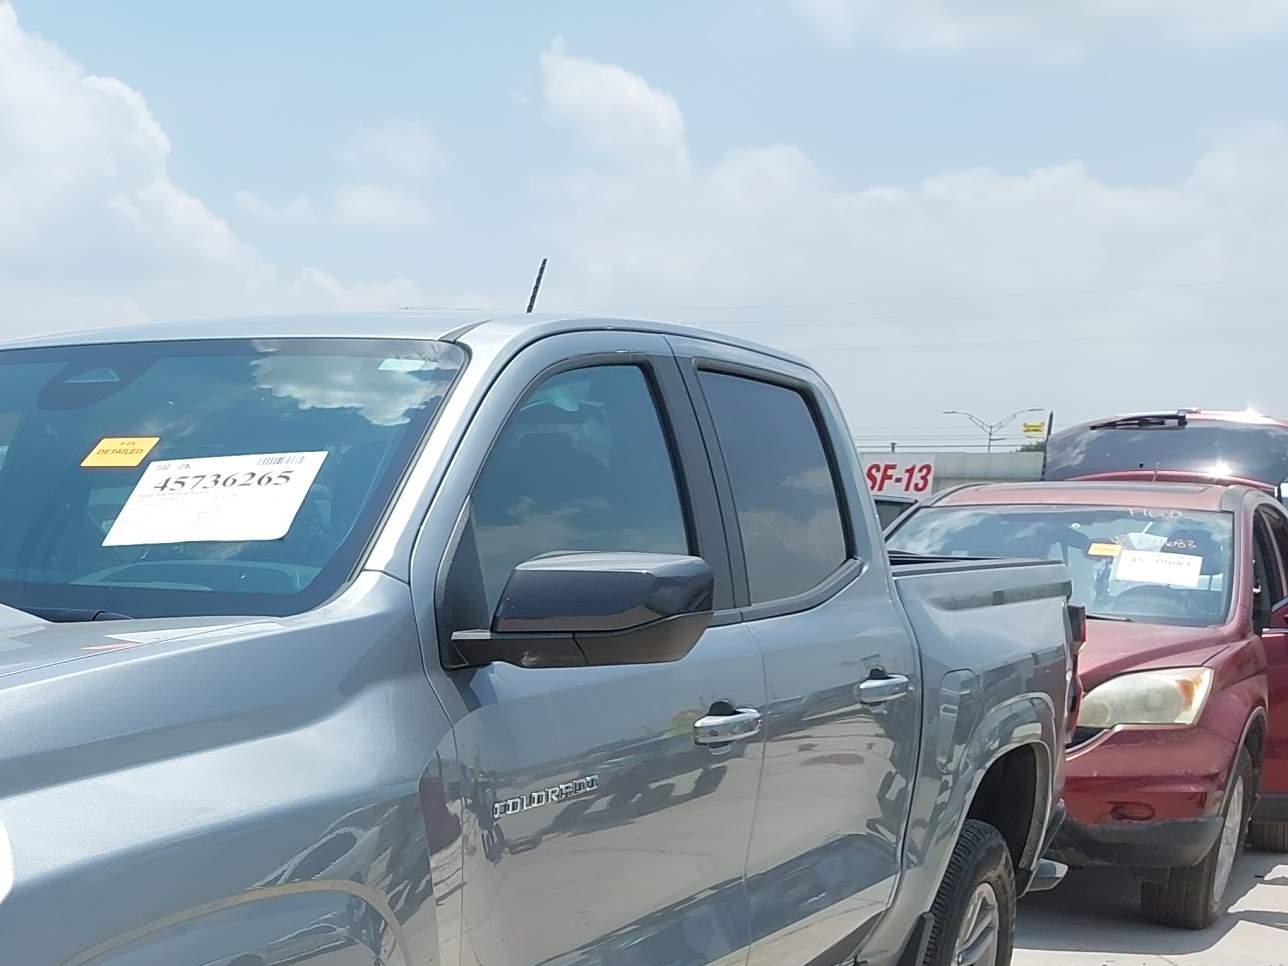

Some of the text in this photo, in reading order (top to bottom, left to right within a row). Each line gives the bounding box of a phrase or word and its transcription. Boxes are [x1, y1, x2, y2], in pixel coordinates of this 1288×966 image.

[153, 470, 296, 492] 45736265
[866, 463, 932, 492] SF-13
[492, 775, 600, 819] COLORADO
